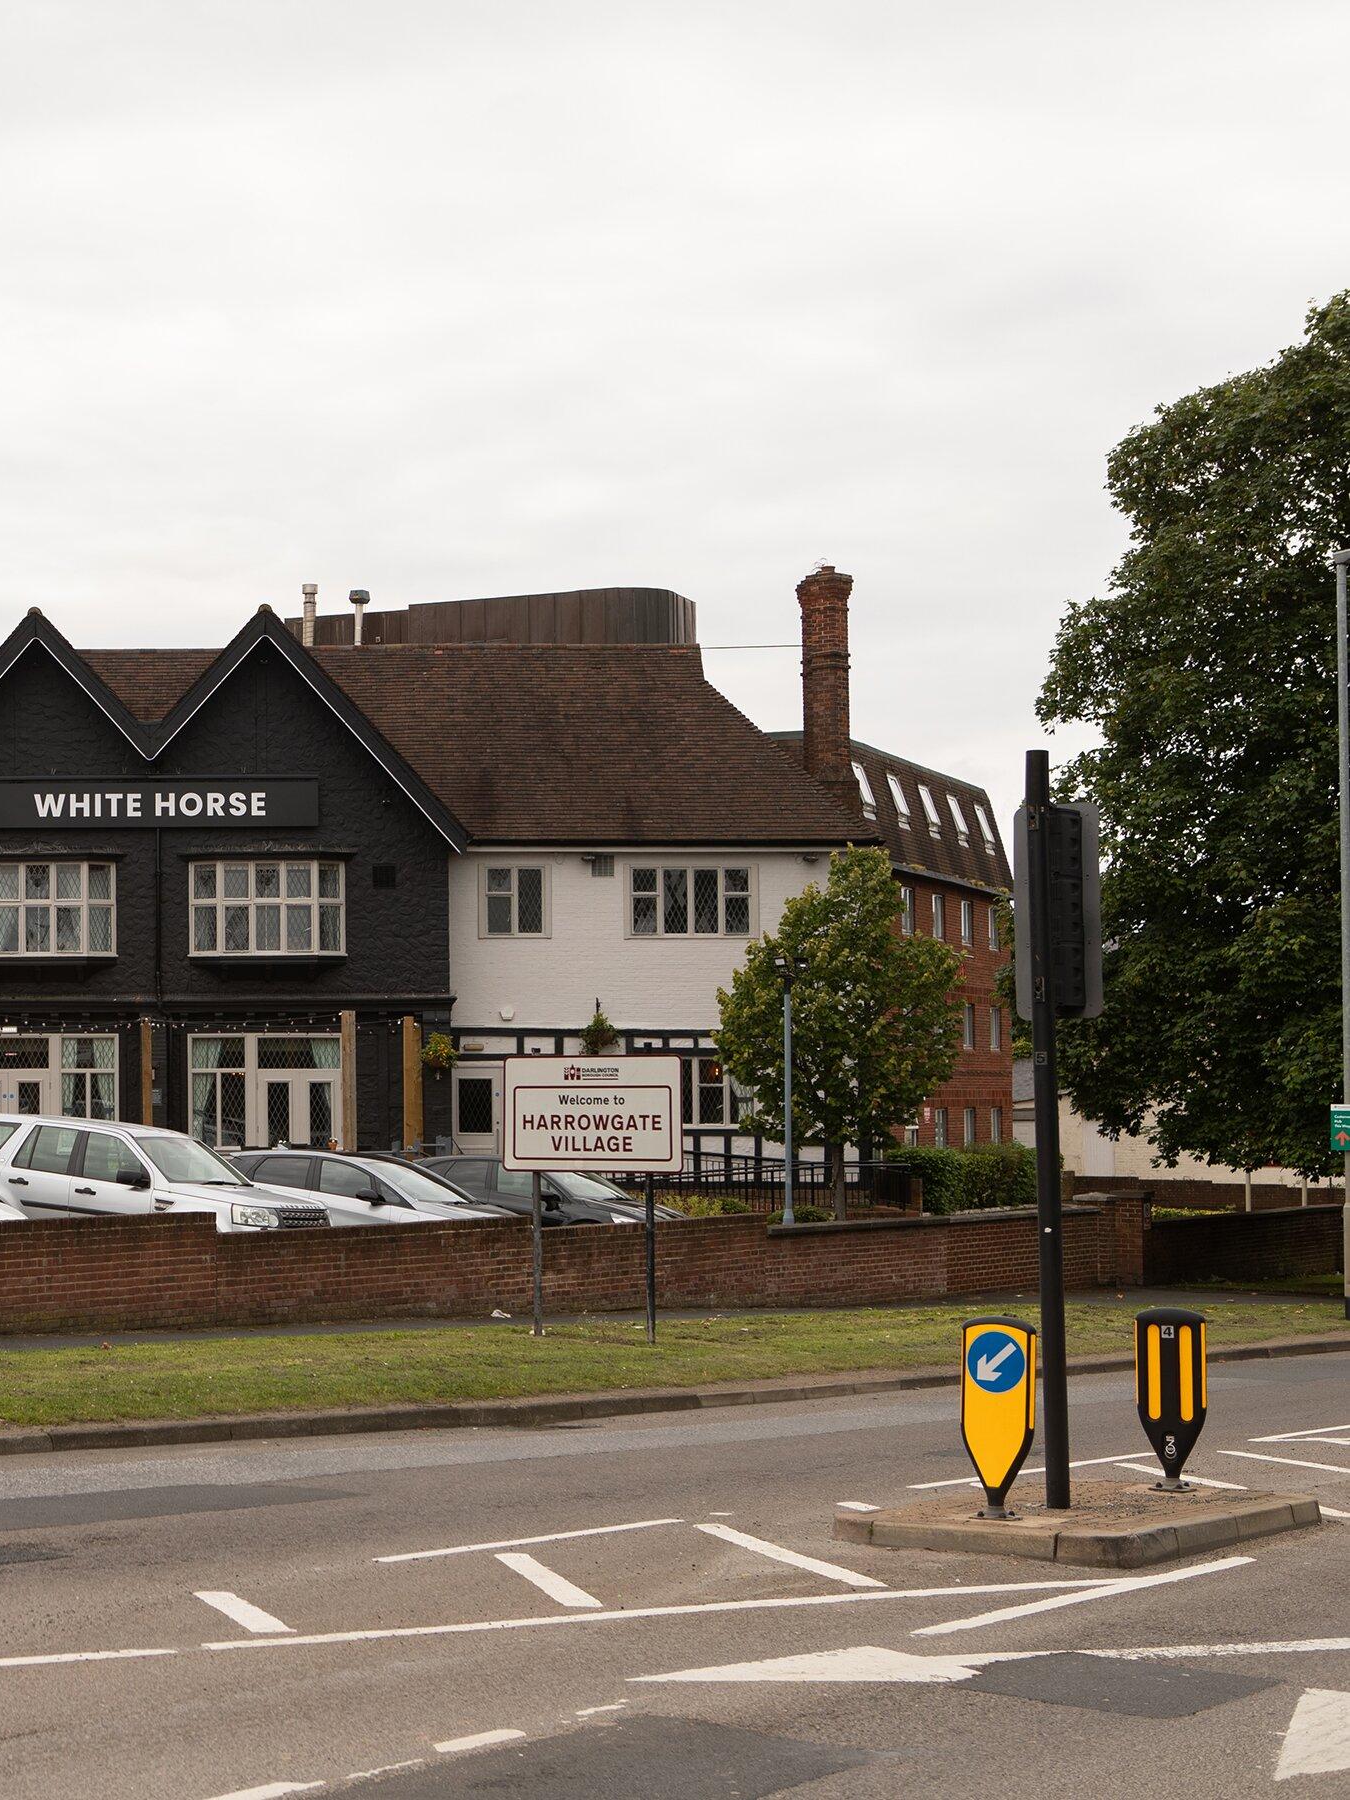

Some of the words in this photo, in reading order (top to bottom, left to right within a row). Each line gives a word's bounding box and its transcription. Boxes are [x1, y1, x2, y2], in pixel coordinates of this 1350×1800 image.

[33, 793, 142, 818] WHITE
[154, 792, 267, 817] HORSE
[1036, 1052, 1045, 1064] 5
[558, 1095, 610, 1106] Welcome
[613, 1095, 625, 1106] to
[522, 1114, 663, 1131] HARROWGATE
[551, 1136, 633, 1153] VILLAGE
[1163, 1326, 1173, 1337] 4
